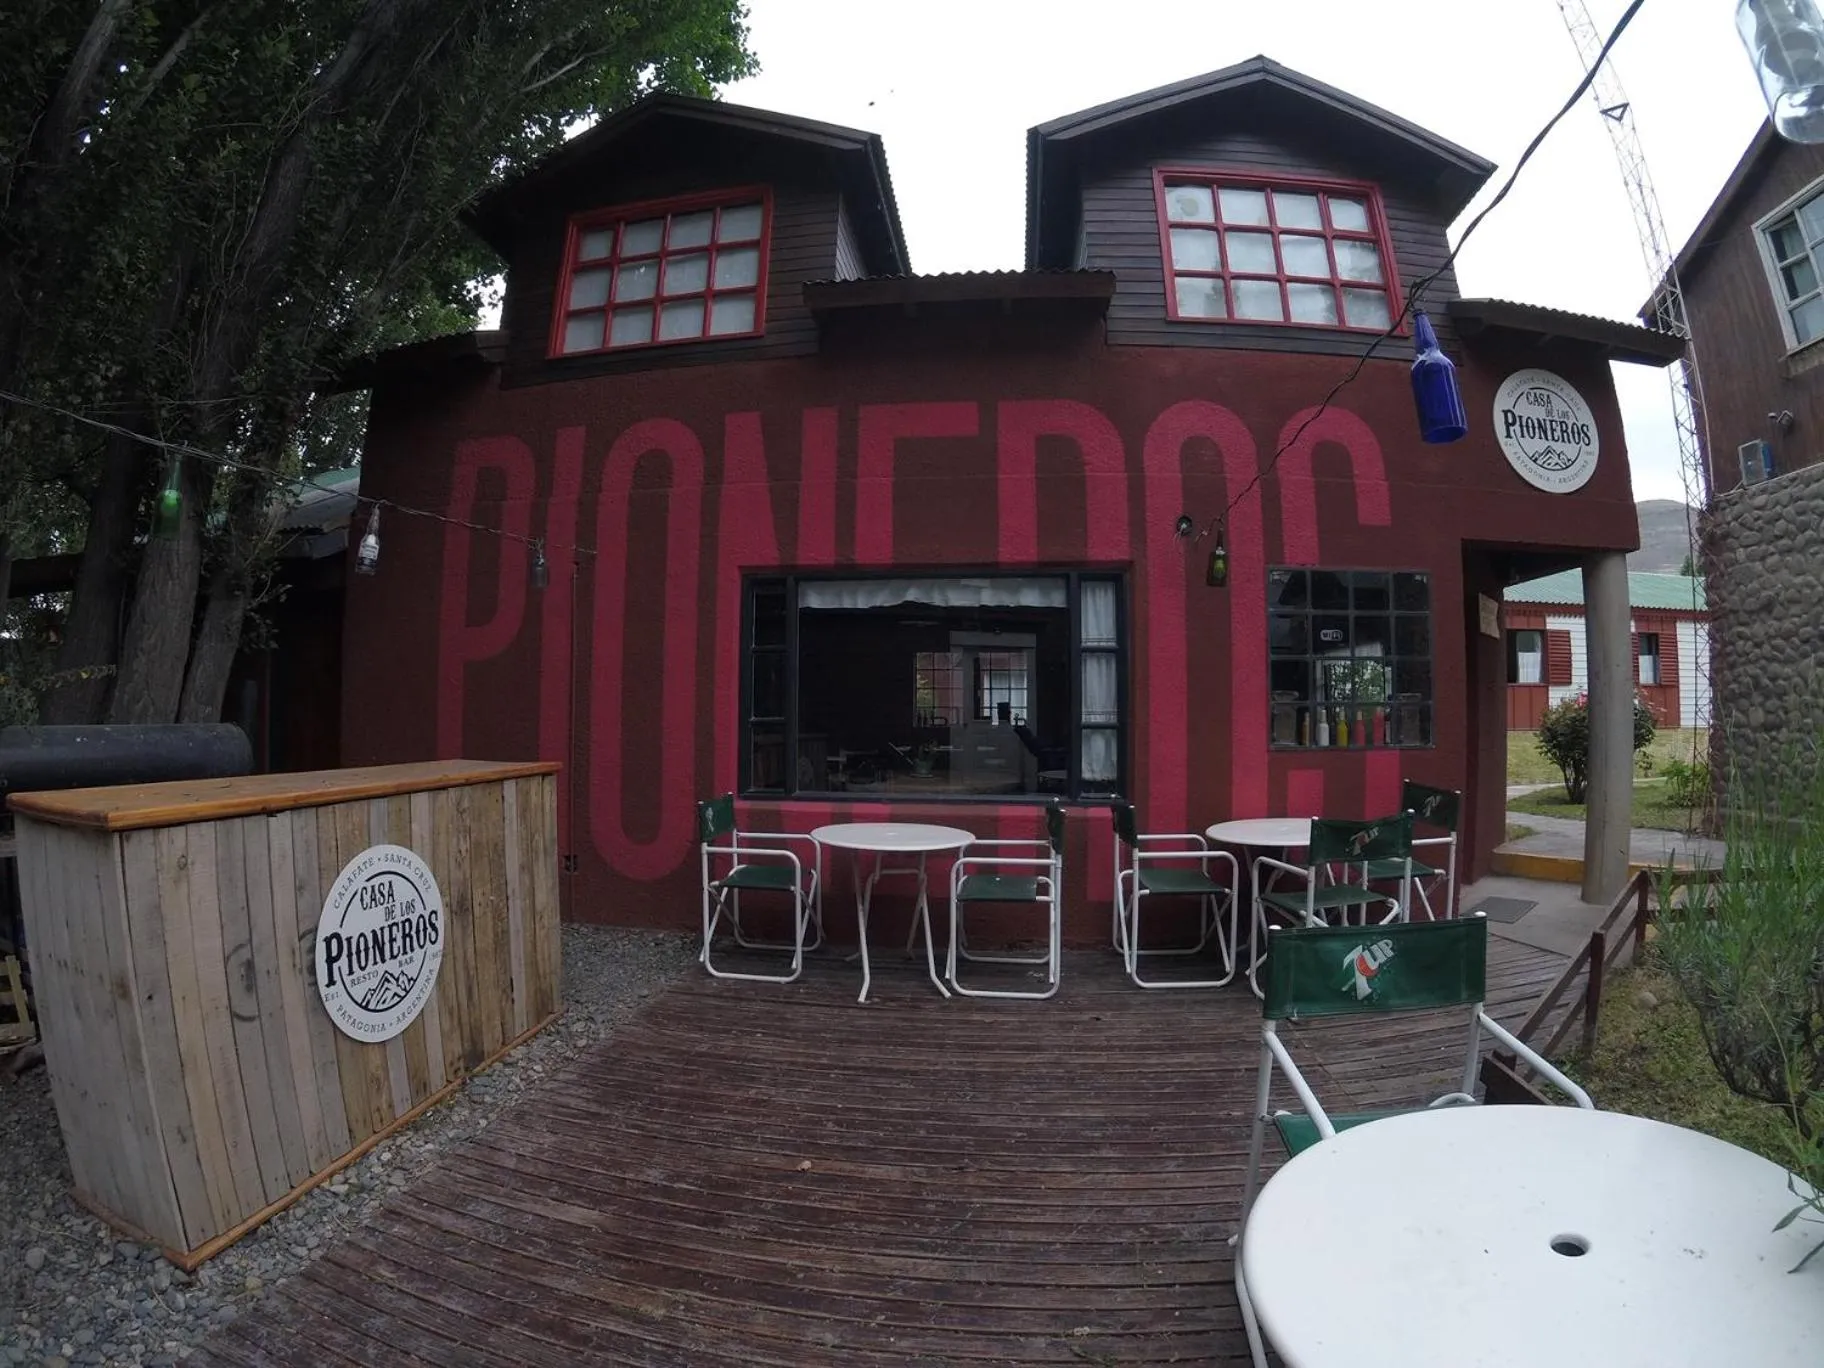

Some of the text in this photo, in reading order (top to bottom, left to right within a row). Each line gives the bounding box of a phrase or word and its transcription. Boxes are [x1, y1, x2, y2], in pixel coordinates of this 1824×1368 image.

[1526, 391, 1552, 408] CASA
[1502, 409, 1591, 446] PIONEROS
[334, 853, 432, 909] CALAFATE SANTA CRUZ
[360, 880, 395, 910] CASA
[384, 898, 416, 922] DE LOS
[322, 909, 439, 988] PIONEROS
[350, 956, 415, 988] RESTO BAR
[336, 968, 434, 1034] PATAGONIA ARGENTINA
